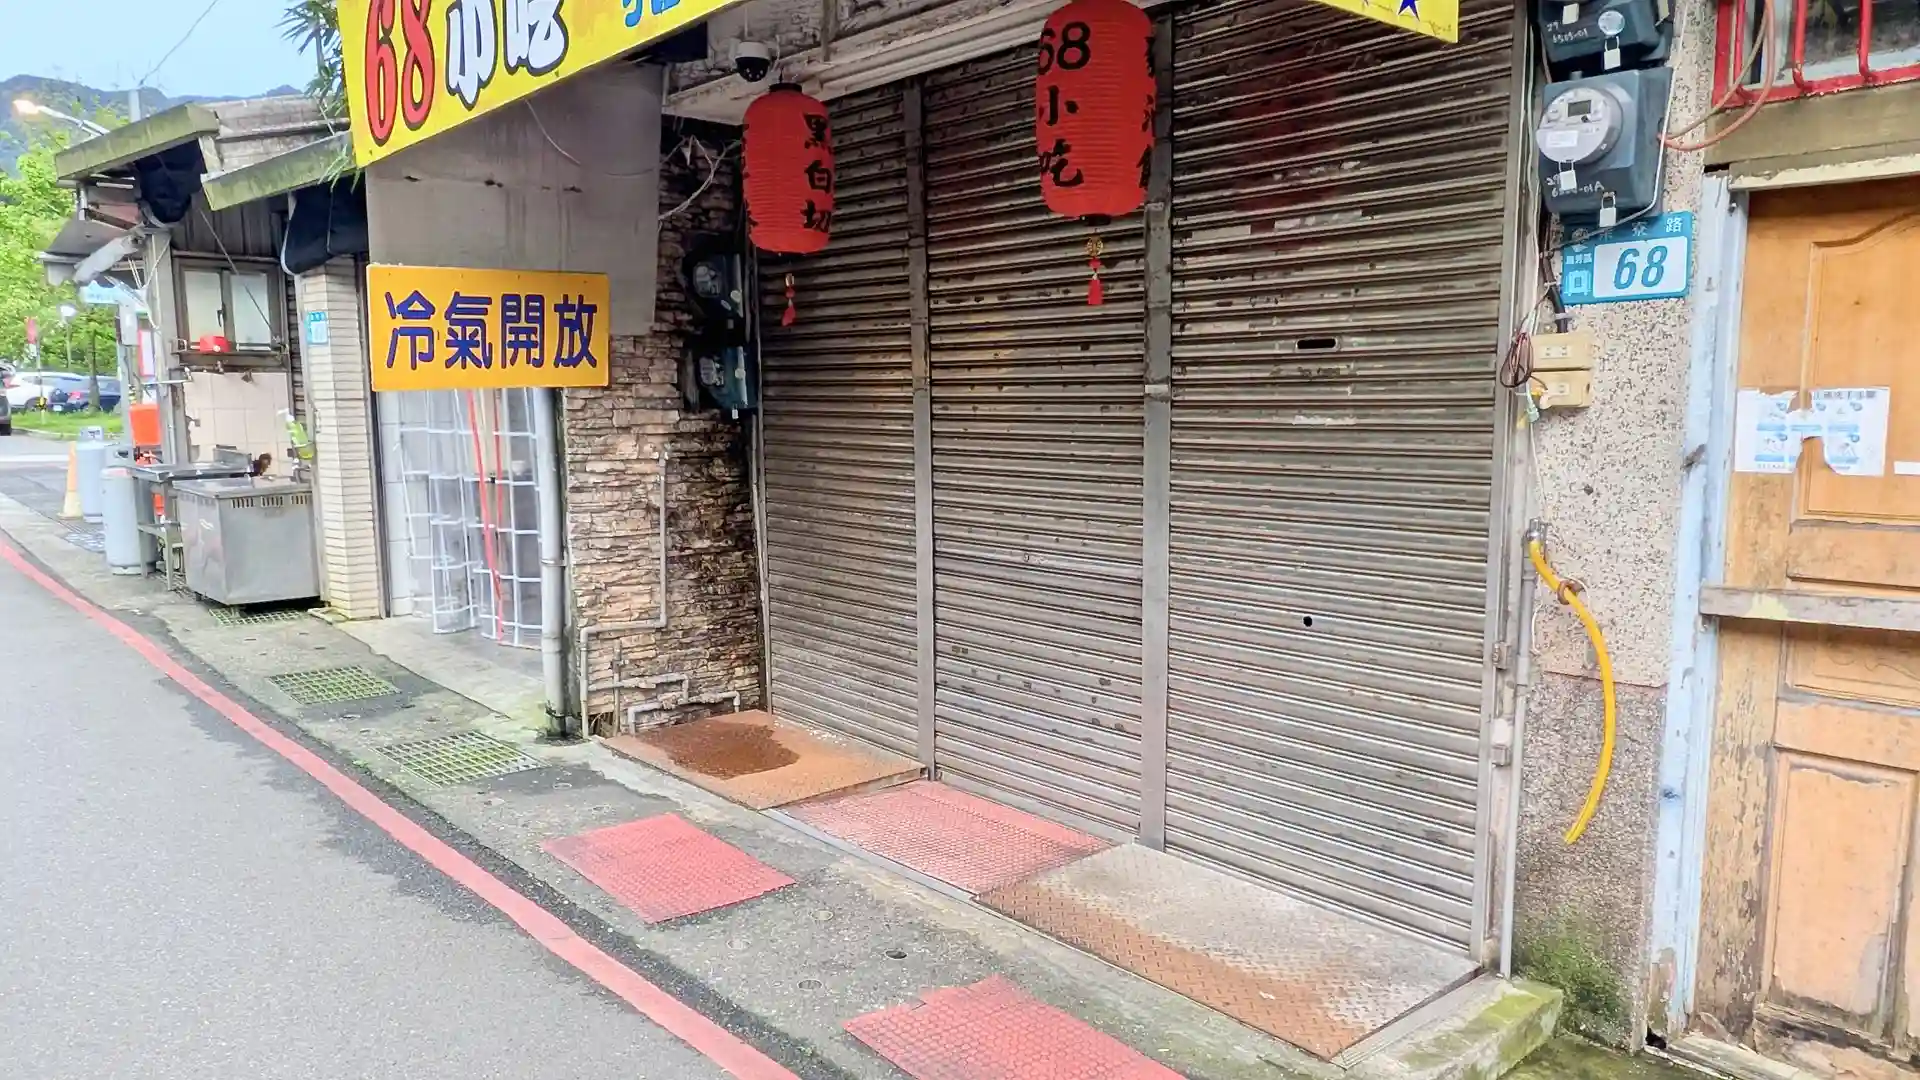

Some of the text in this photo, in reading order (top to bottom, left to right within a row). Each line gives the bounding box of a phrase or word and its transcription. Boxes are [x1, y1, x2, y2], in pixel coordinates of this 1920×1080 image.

[1613, 245, 1668, 290] 68
[384, 289, 598, 371] 冷氣開放
